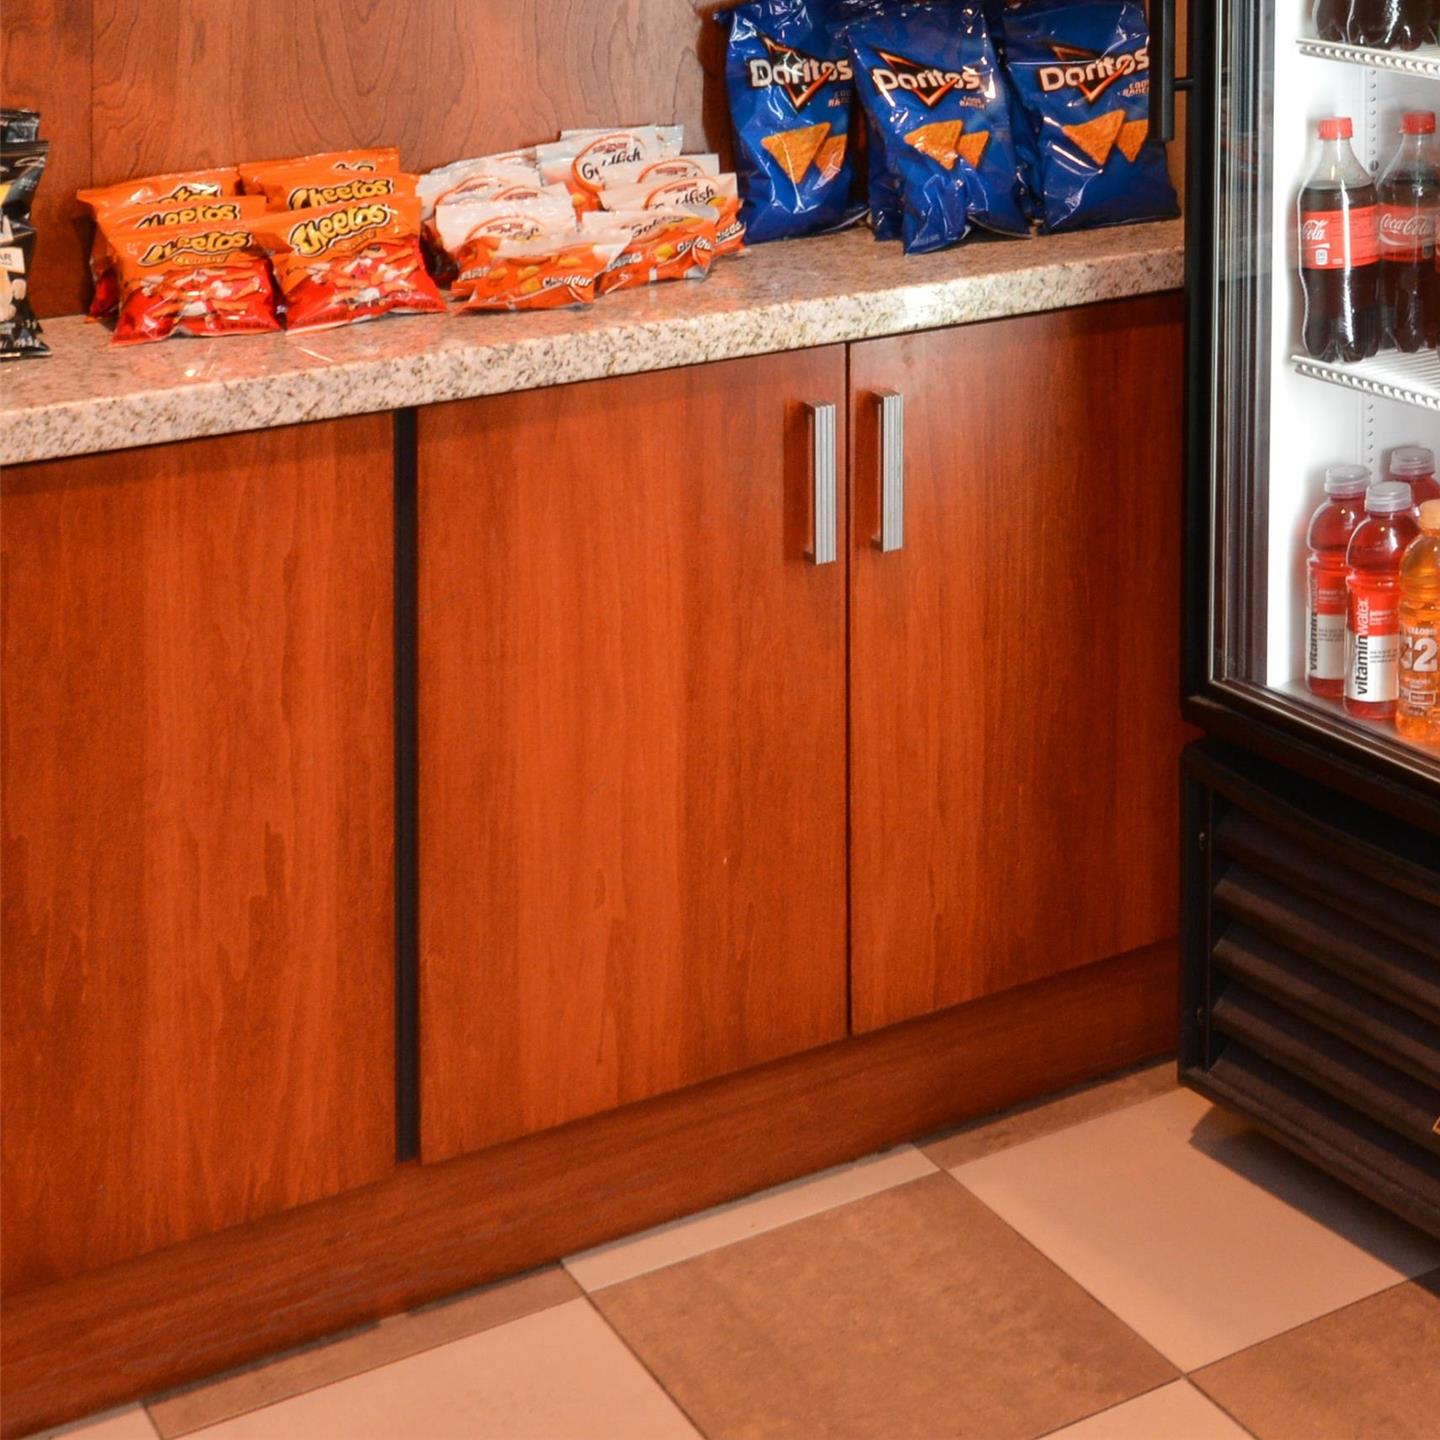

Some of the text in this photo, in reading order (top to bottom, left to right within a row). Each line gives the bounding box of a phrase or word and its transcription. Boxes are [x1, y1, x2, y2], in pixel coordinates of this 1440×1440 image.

[750, 57, 853, 88] Doritos
[872, 67, 981, 91] Doritos
[1039, 48, 1149, 92] Doritos
[288, 178, 392, 210] Cheetos
[290, 203, 391, 257] Cheetos
[141, 231, 251, 266] eetos
